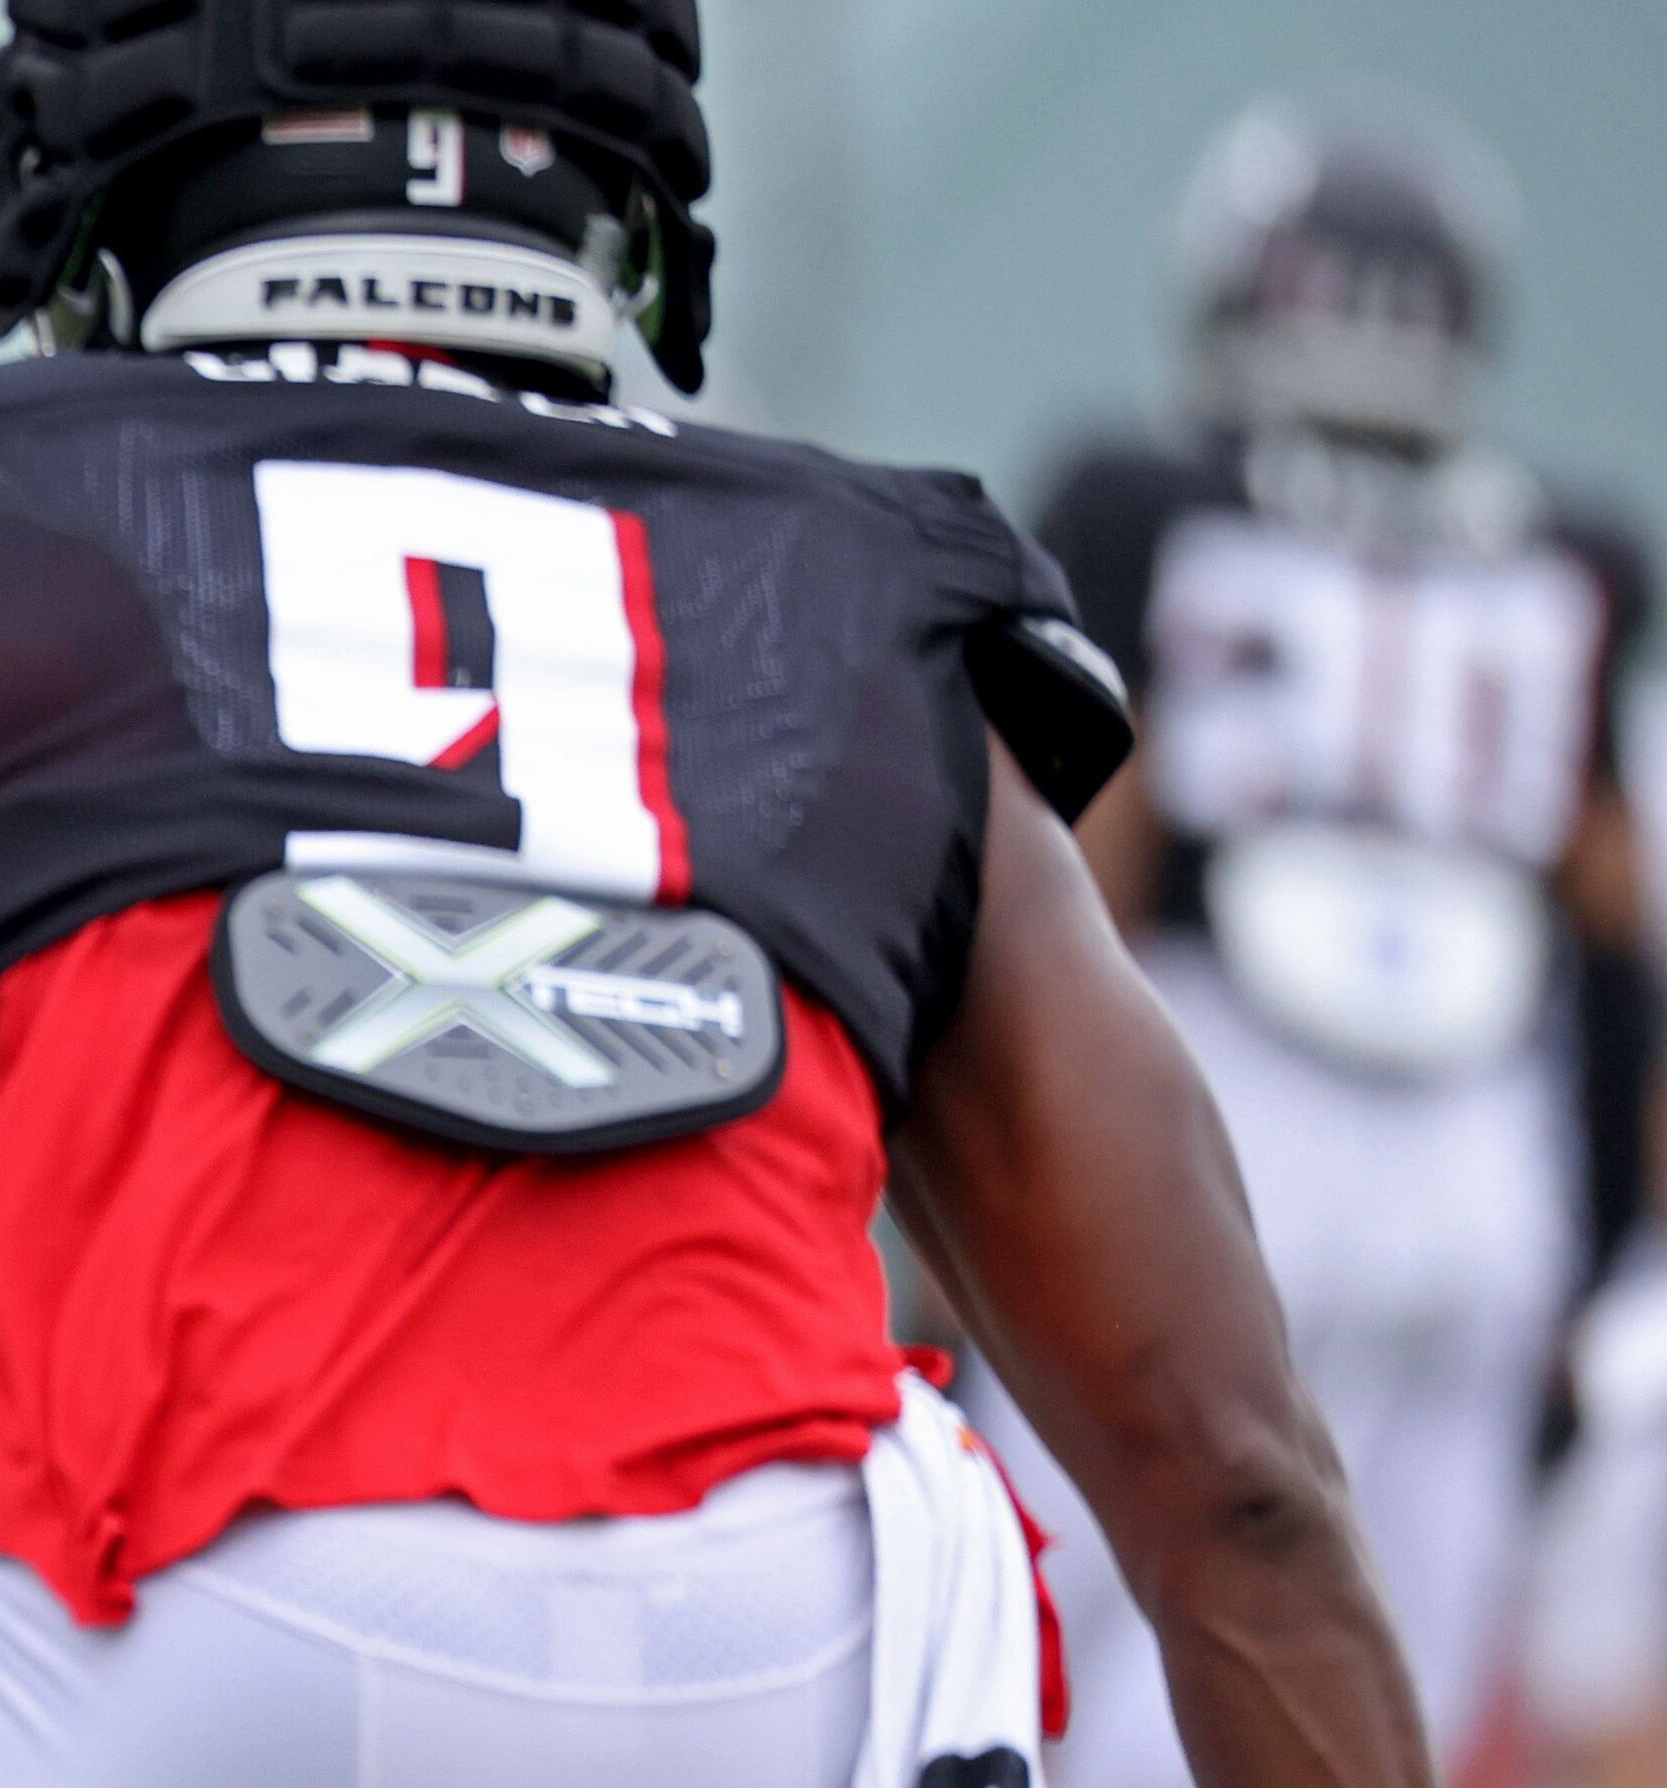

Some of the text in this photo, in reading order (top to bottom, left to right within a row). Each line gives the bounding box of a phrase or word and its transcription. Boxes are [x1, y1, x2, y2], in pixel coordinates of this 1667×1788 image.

[406, 108, 466, 207] 9
[259, 277, 578, 328] FALCONS
[252, 457, 690, 906] 9
